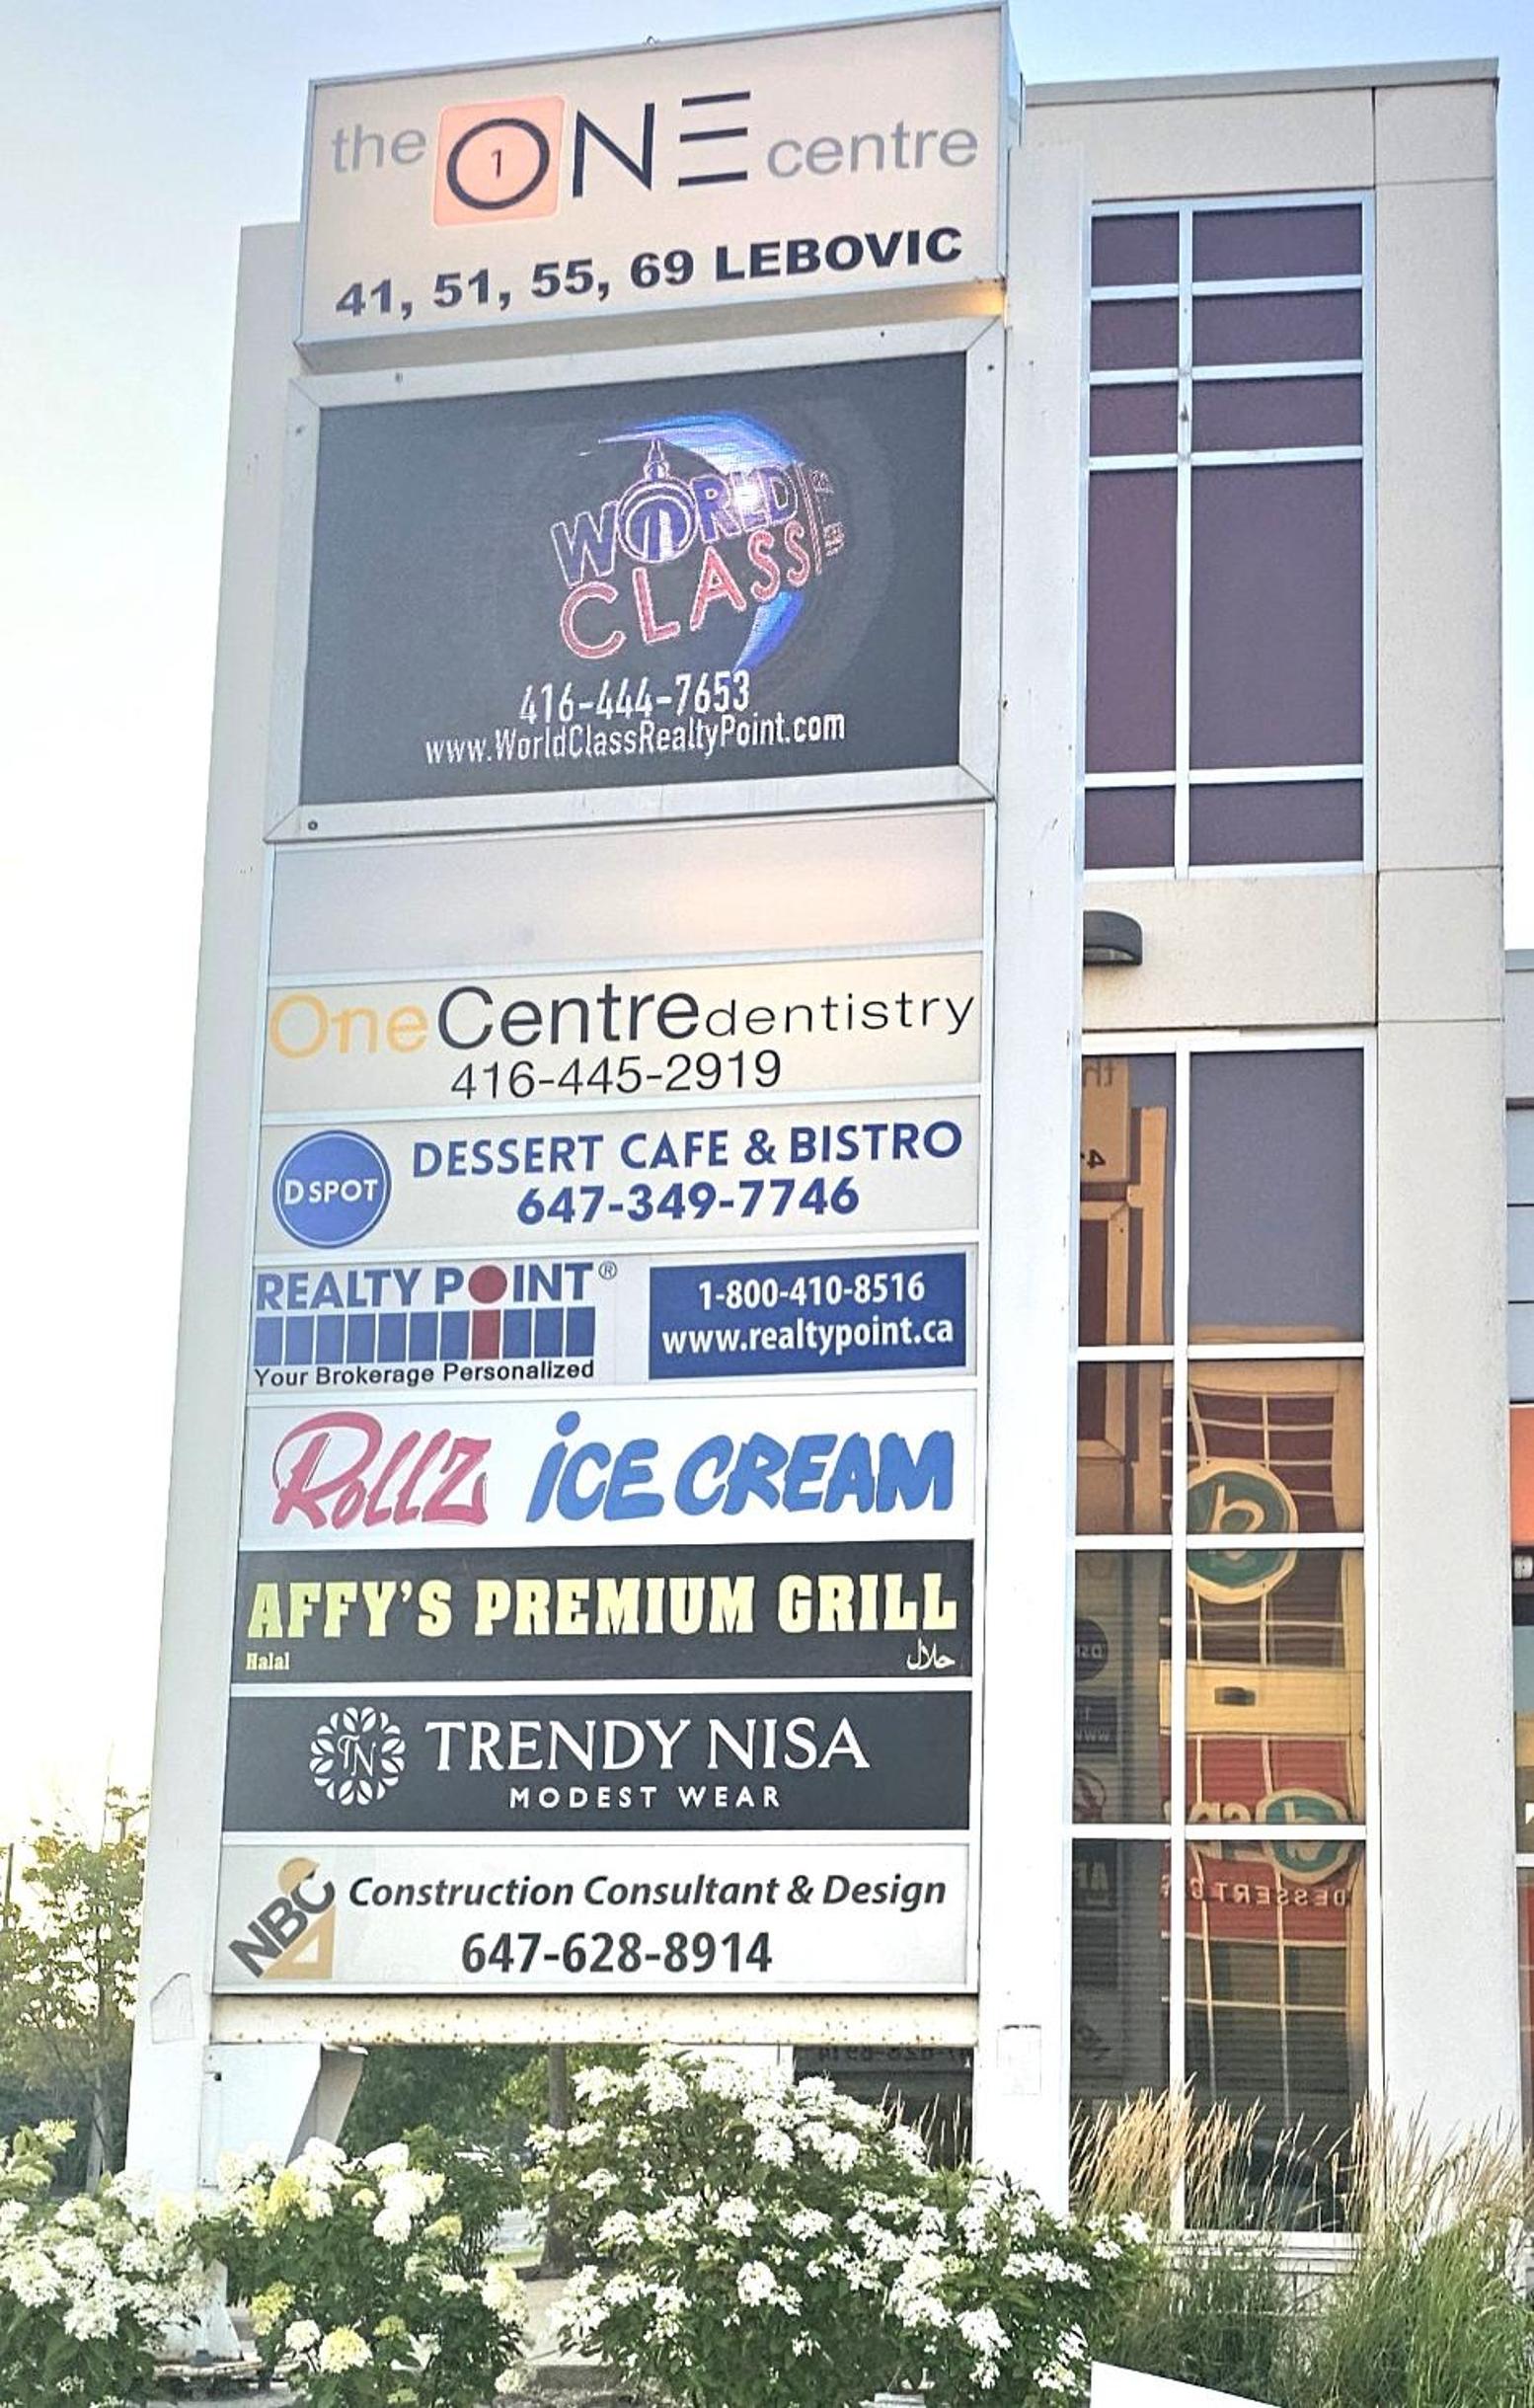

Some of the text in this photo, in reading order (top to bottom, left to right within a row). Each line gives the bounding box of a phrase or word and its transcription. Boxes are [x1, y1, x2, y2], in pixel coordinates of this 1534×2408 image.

[332, 91, 977, 210] the ONE centre
[336, 227, 962, 321] 41, 51, 55, 69 LEBOVIC
[550, 462, 799, 588] WORLD
[559, 519, 811, 660] CLASS
[519, 670, 750, 724] 416-444-7653
[425, 712, 846, 763] www.WorldClassRealtyPoint.com
[450, 1049, 781, 1100] 416-445-2919
[414, 1121, 961, 1178] DESSERT CAFE & BISTRO
[517, 1176, 859, 1225] 647-349-7746
[257, 1266, 422, 1311] REALTY
[700, 1272, 924, 1310] 1-800-410-8516
[662, 1315, 953, 1356] www.realtypoint.ca
[254, 1359, 593, 1388] Your Brokerage Personalized
[674, 1431, 954, 1515] CREAM
[248, 1573, 957, 1638] AFFY'S PREMIUM GRILL
[246, 1652, 289, 1670] Halal
[907, 1638, 955, 1670] حلال
[425, 1718, 870, 1770] TRENDY NISA
[510, 1786, 779, 1808] MODEST WEAR
[349, 1874, 946, 1910] Construction Consultant & Design
[228, 1869, 335, 1978] NBC
[462, 1932, 772, 1973] 647-628-8914
